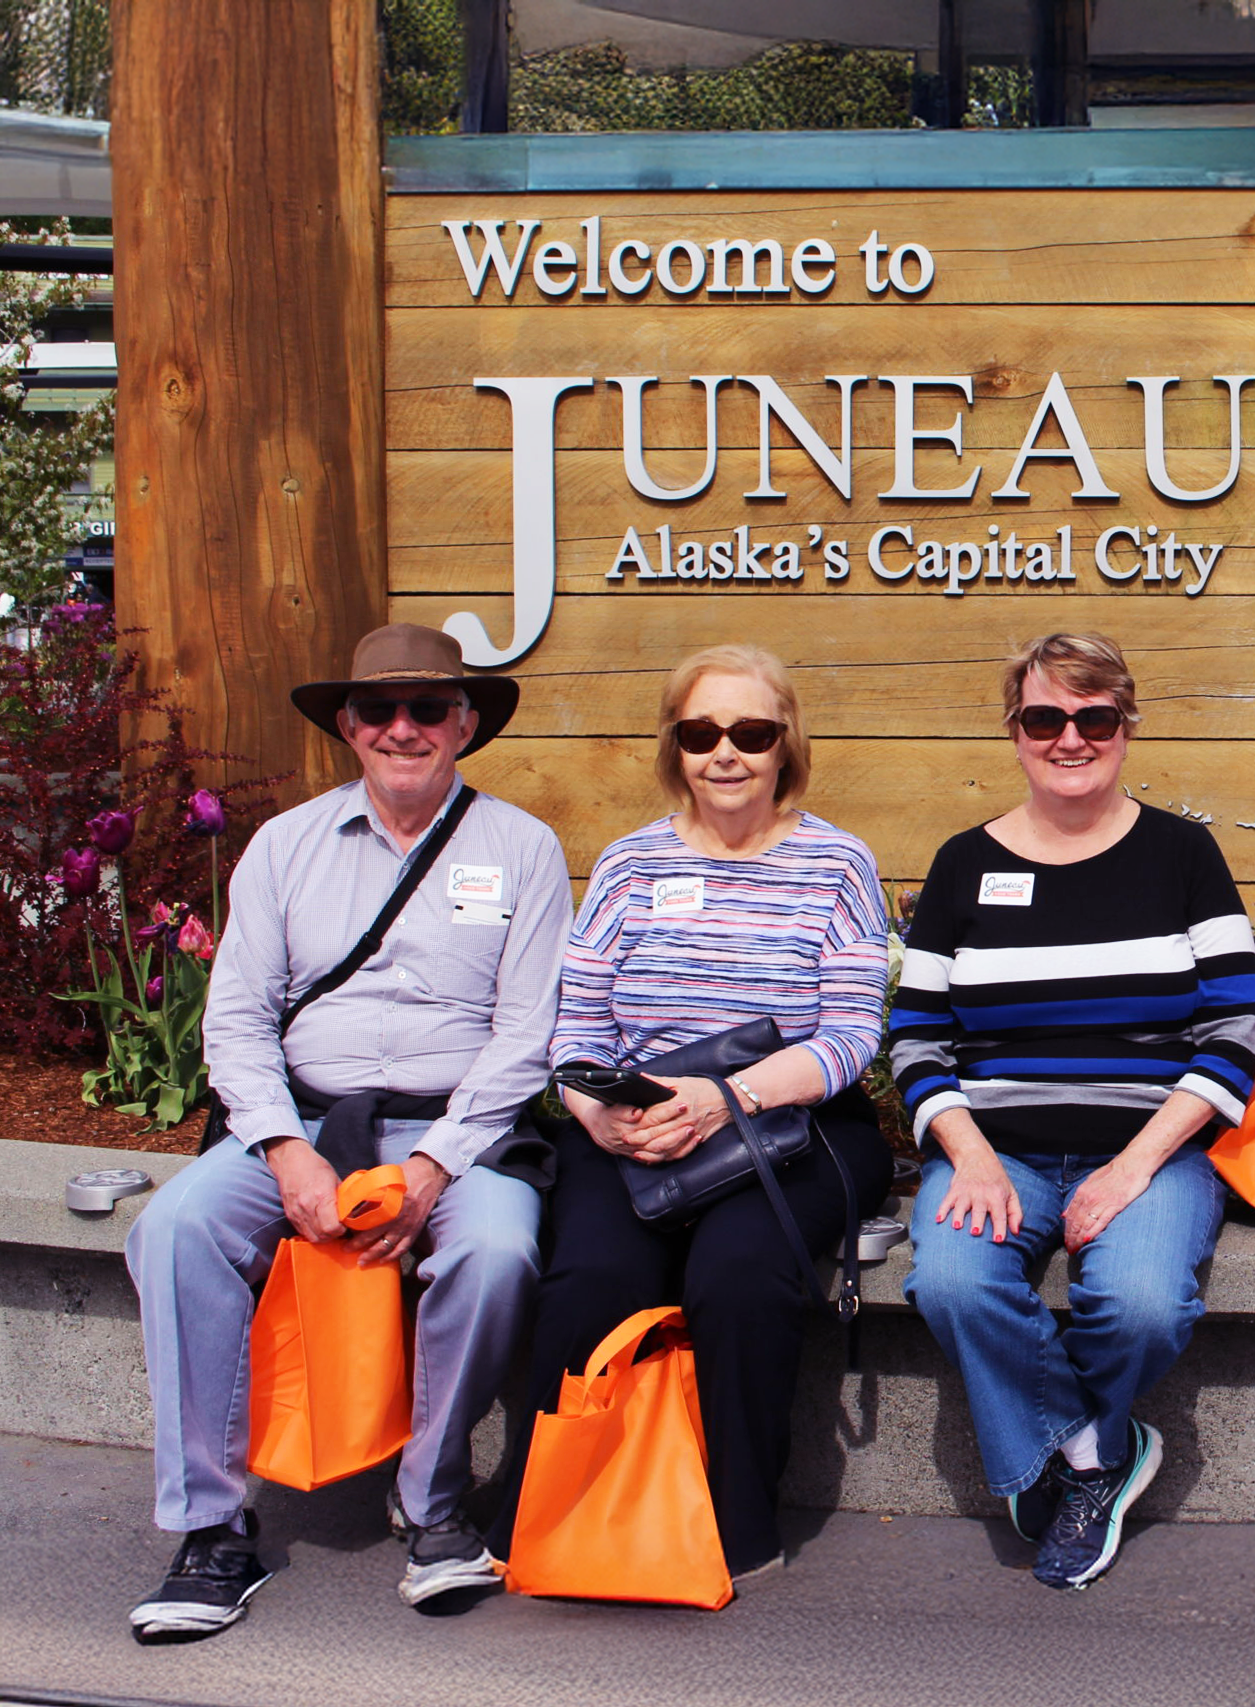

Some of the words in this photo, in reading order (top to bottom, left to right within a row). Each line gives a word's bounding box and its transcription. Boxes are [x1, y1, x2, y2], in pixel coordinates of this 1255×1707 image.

[441, 216, 836, 297] Welcome
[859, 229, 935, 295] to
[605, 524, 850, 581] Alaska's
[867, 525, 1077, 596] Capital
[1095, 525, 1224, 597] City
[453, 868, 495, 890] Juneau
[984, 876, 1025, 897] Juneau
[657, 883, 696, 907] Juneau
